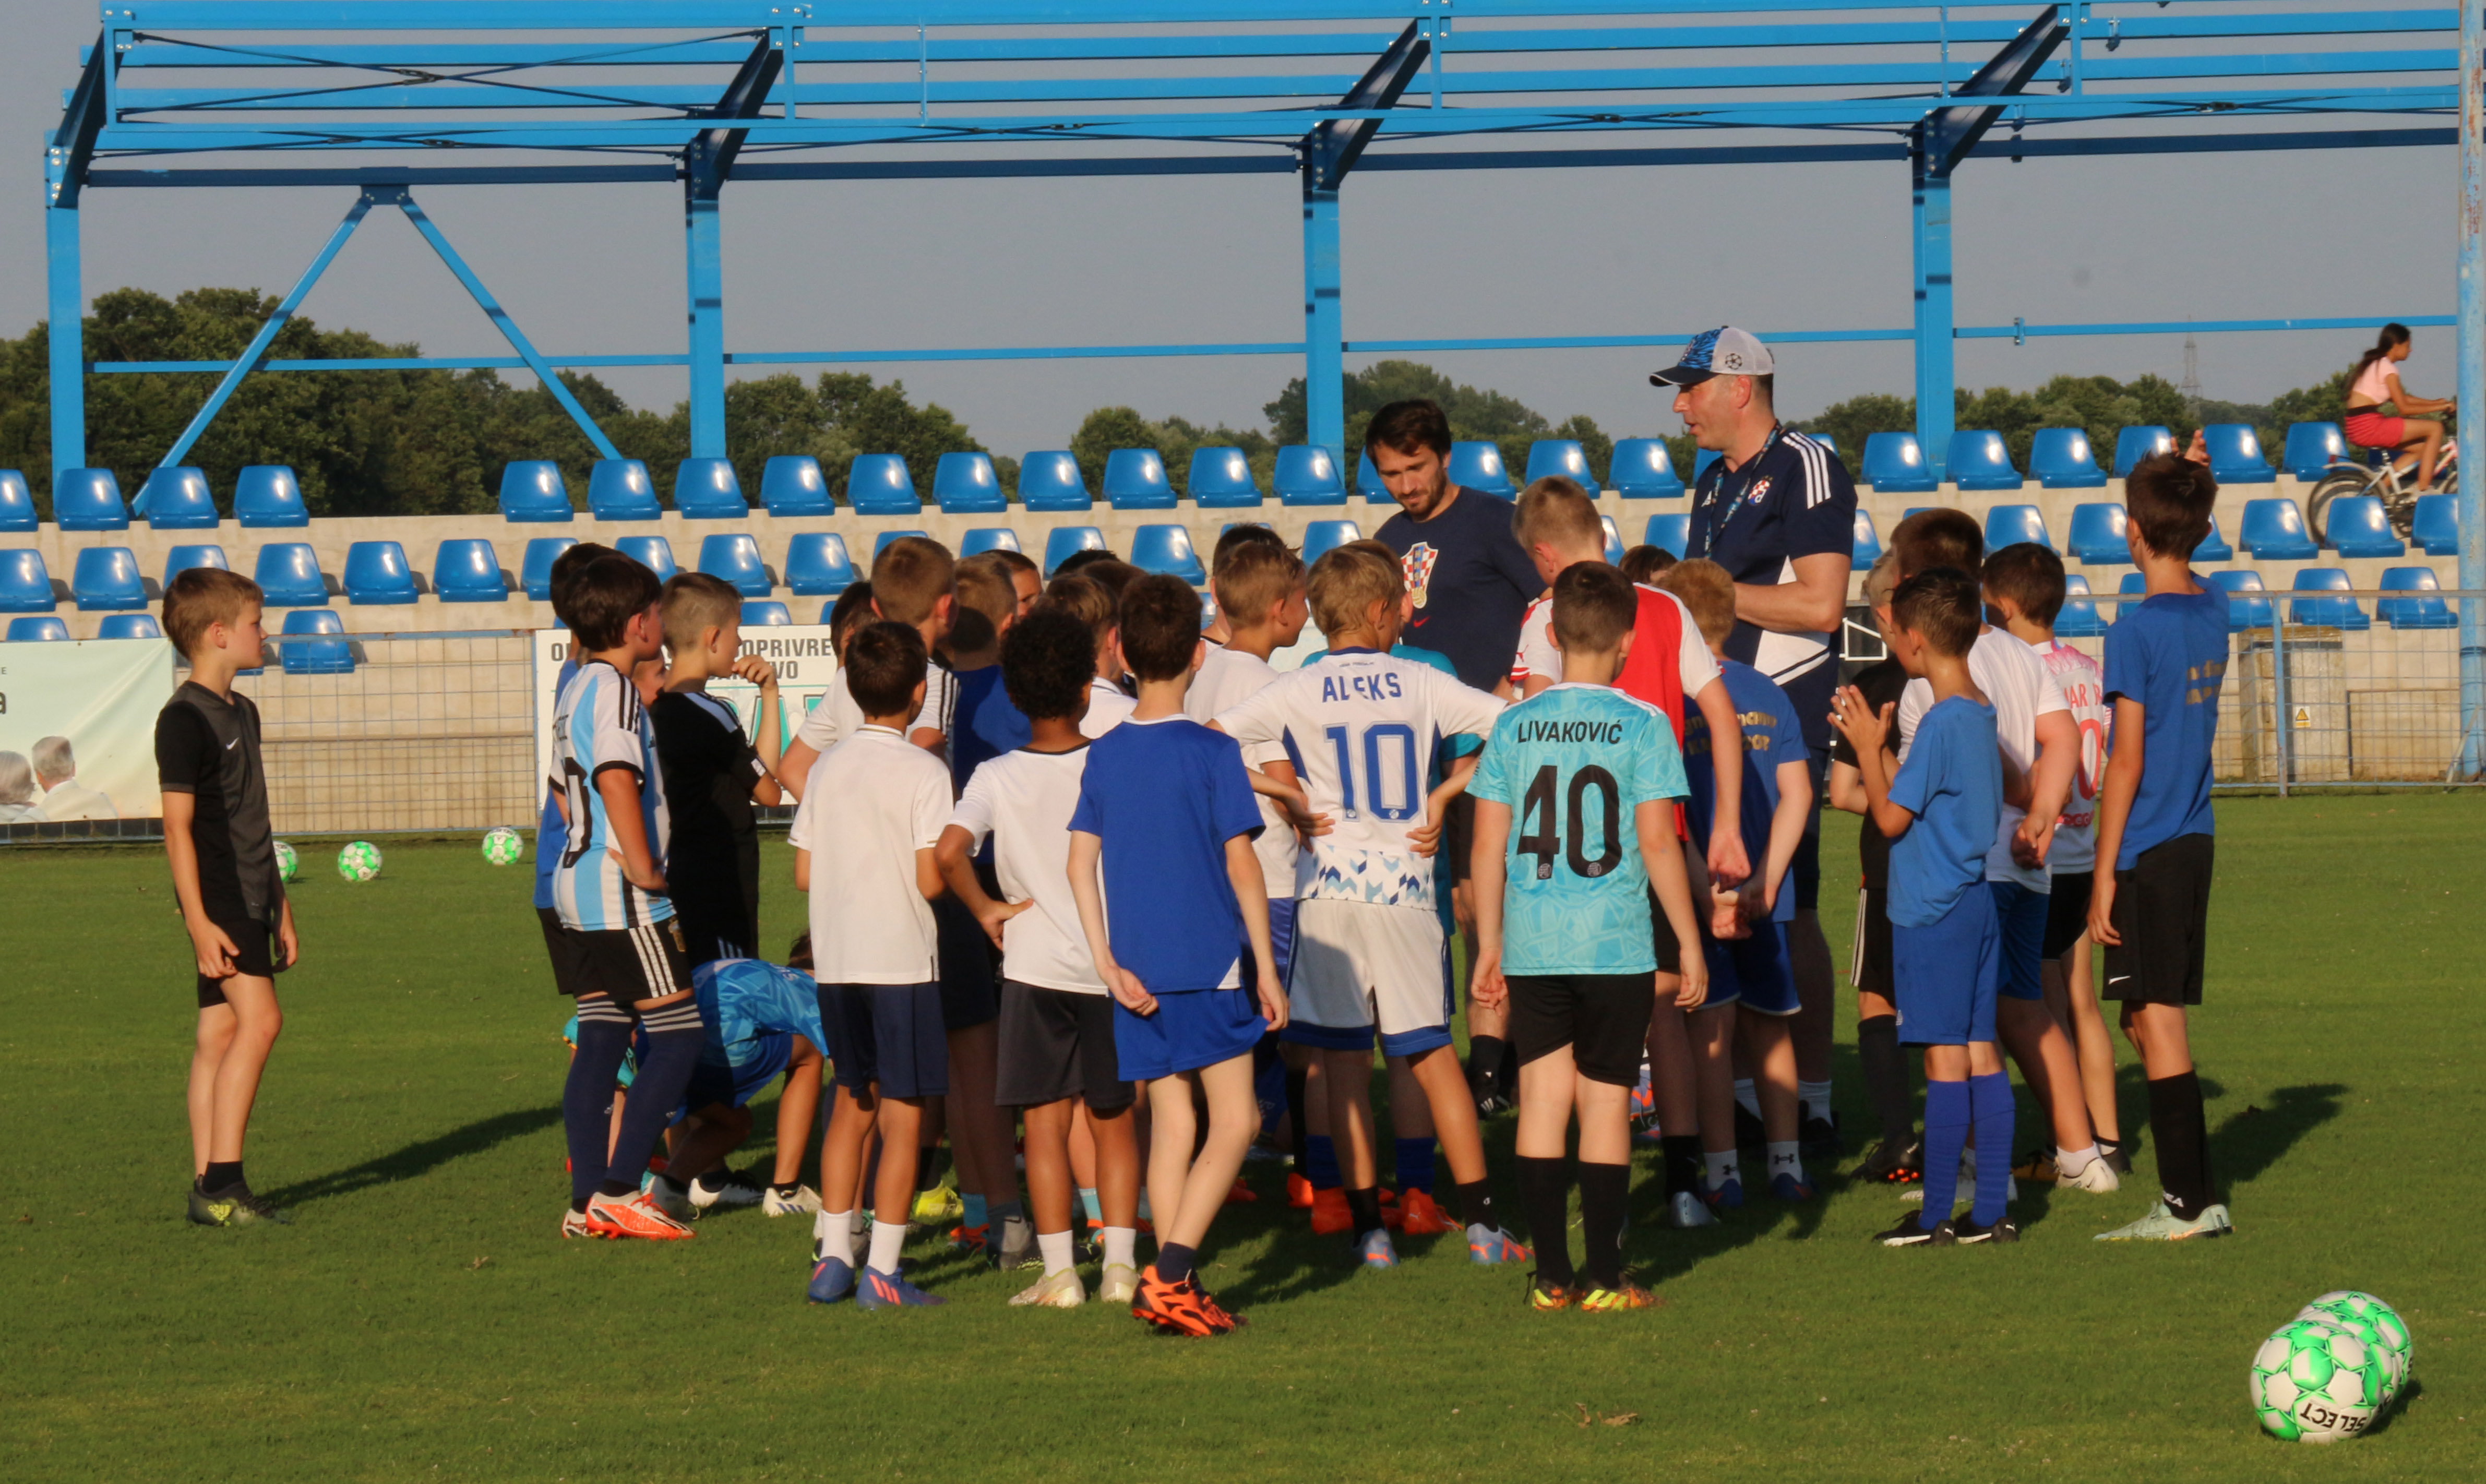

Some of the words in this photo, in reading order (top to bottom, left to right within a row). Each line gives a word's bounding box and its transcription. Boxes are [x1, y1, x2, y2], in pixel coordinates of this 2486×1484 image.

[736, 638, 832, 657] OPRIVRE
[1322, 672, 1402, 703] ALEKS
[1517, 719, 1623, 744] LIVAKOVIĆ
[1322, 720, 1418, 823] 10
[1516, 764, 1622, 880] 40
[2300, 1403, 2367, 1432] SELECT
